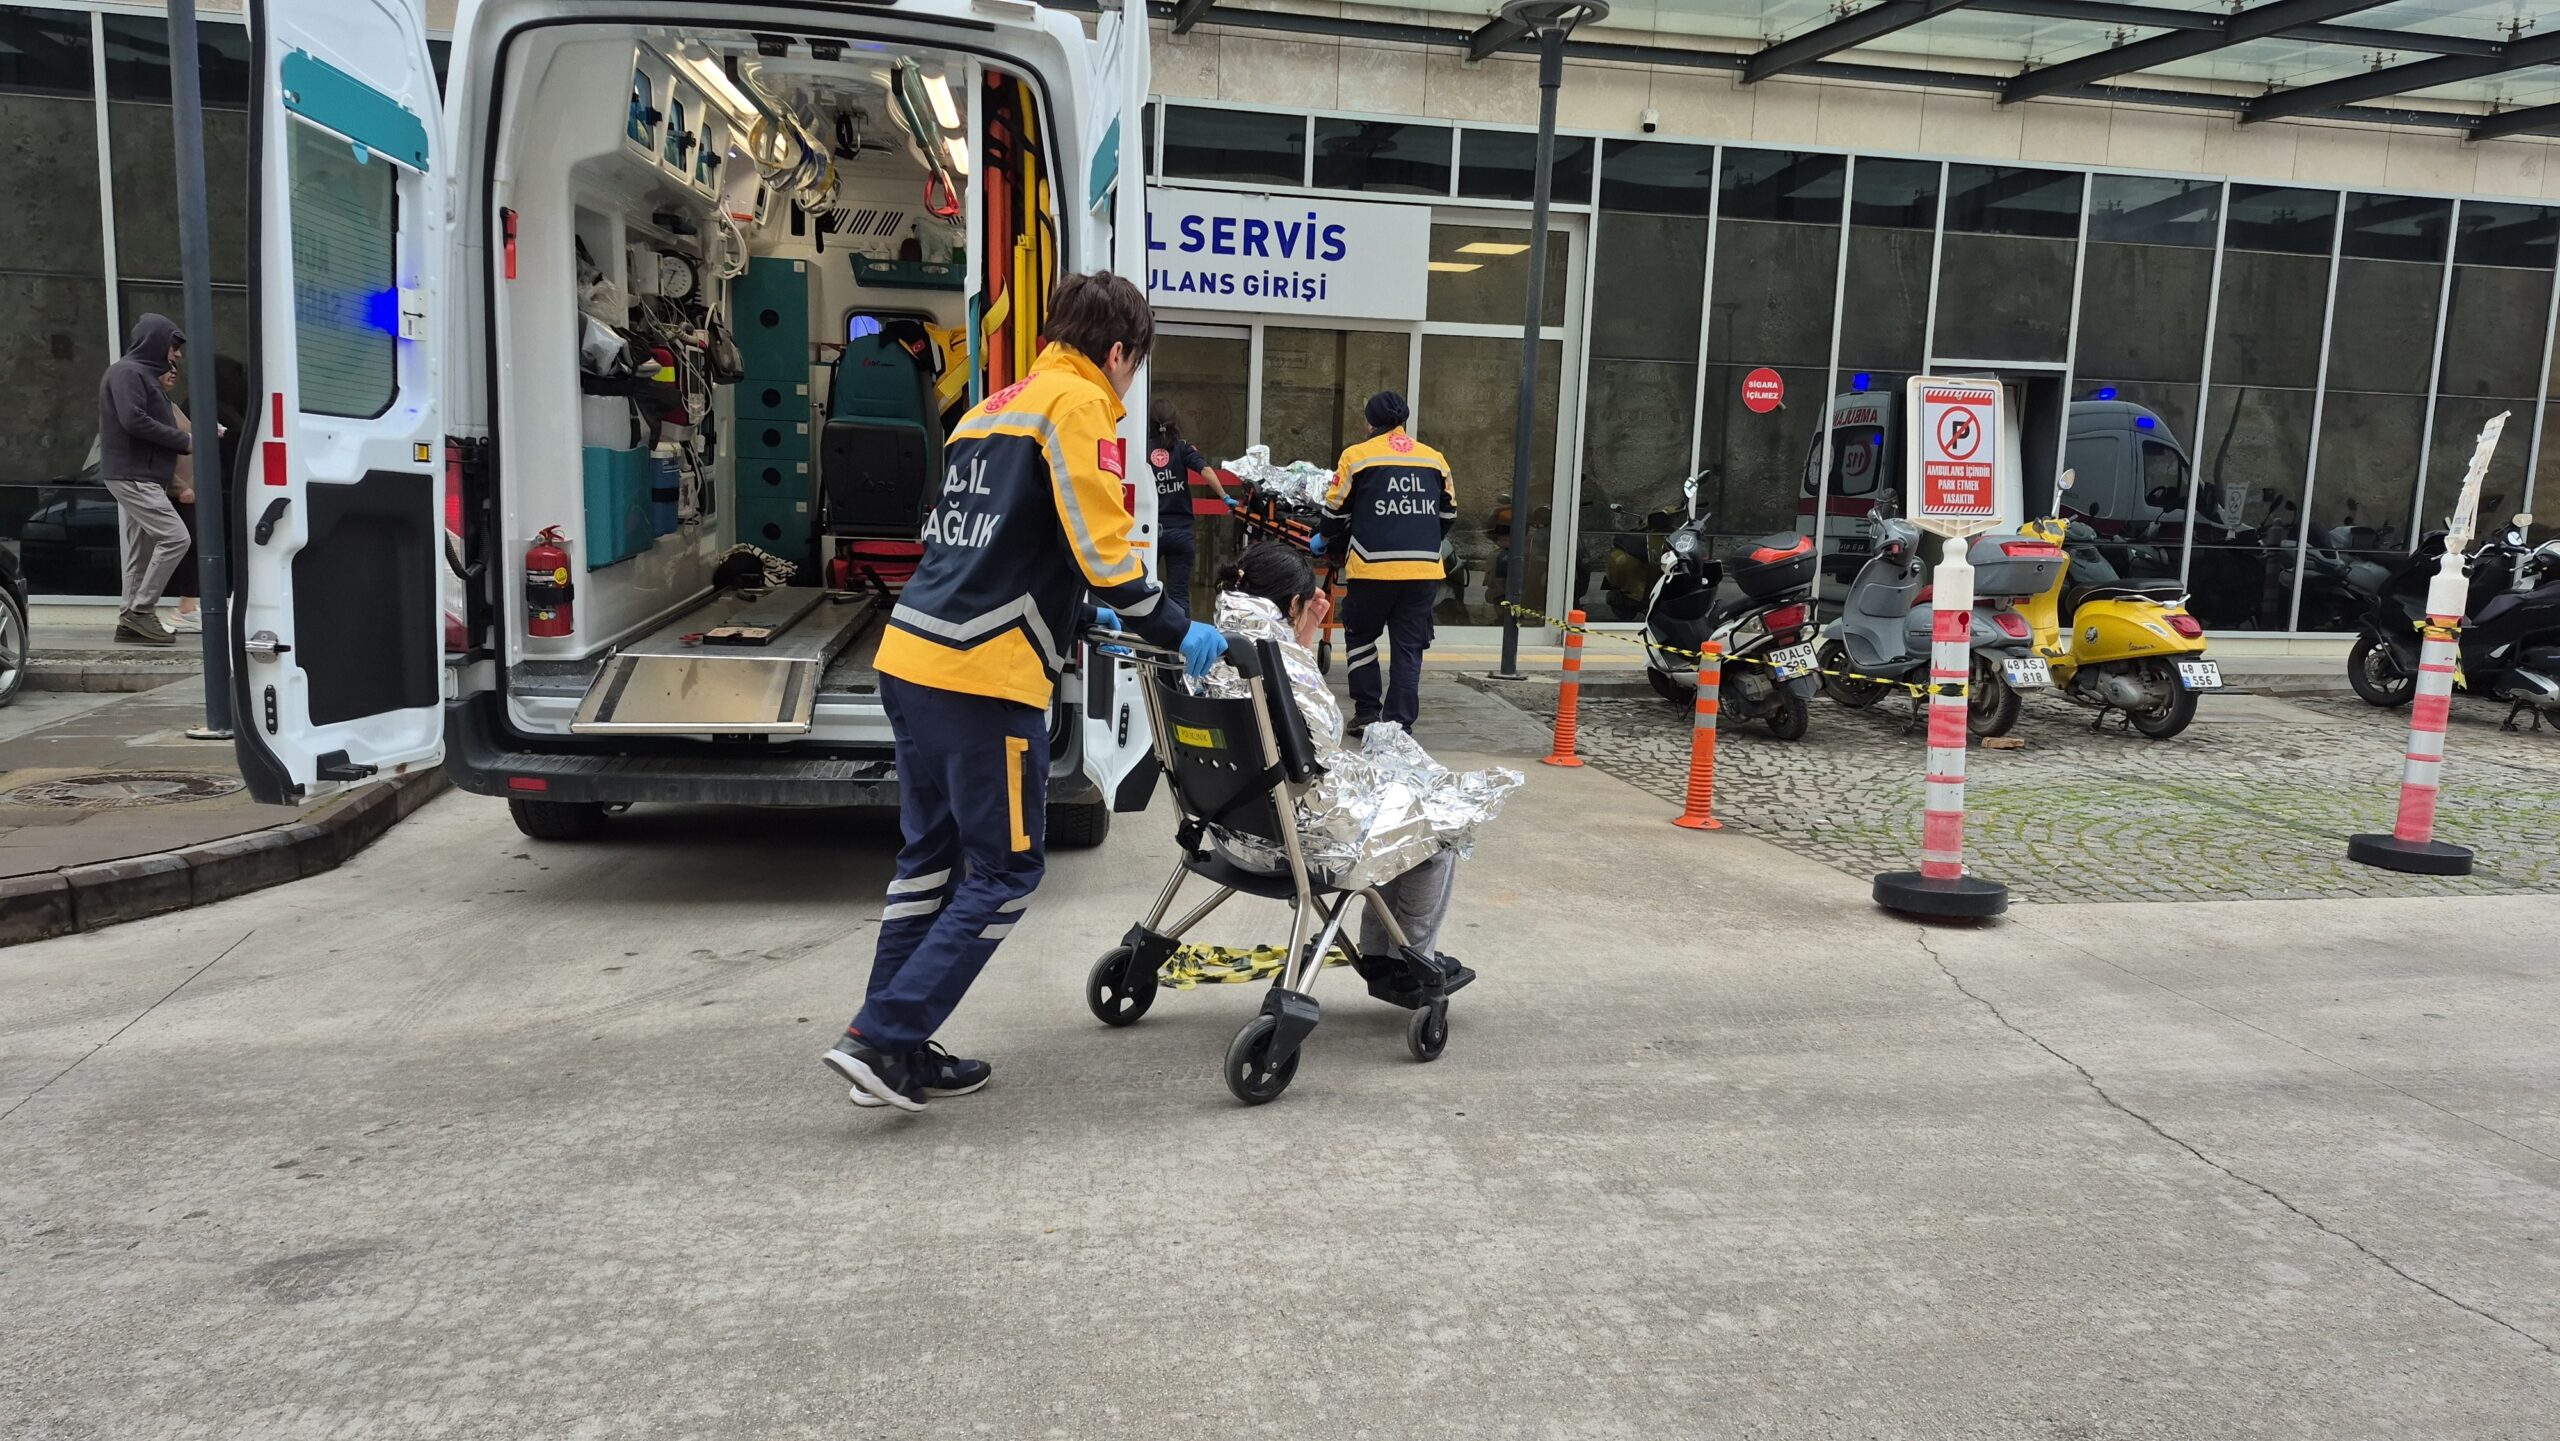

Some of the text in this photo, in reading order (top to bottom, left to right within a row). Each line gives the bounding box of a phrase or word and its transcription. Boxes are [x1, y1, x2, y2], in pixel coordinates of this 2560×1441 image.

[1179, 212, 1347, 262] SERVİS
[1243, 270, 1326, 302] GİRİŞİ
[1748, 380, 1778, 389] SİGARA
[1746, 390, 1779, 400] İÇİLMEZ
[1156, 469, 1176, 481] CİL
[1926, 464, 1965, 477] AMBULANS
[1157, 481, 1185, 494] ĞLIK
[1387, 473, 1426, 492] ACİL
[1937, 479, 1980, 491] PARK ETMEK
[1375, 495, 1436, 516] SAĞLIK
[921, 501, 1000, 548] AĞLIK
[1772, 645, 1812, 663] 20 ALG
[2007, 660, 2045, 670] 48 ASJ
[2182, 664, 2217, 674] 48 BZ
[2022, 672, 2043, 682] 818
[2192, 676, 2213, 686] 556
